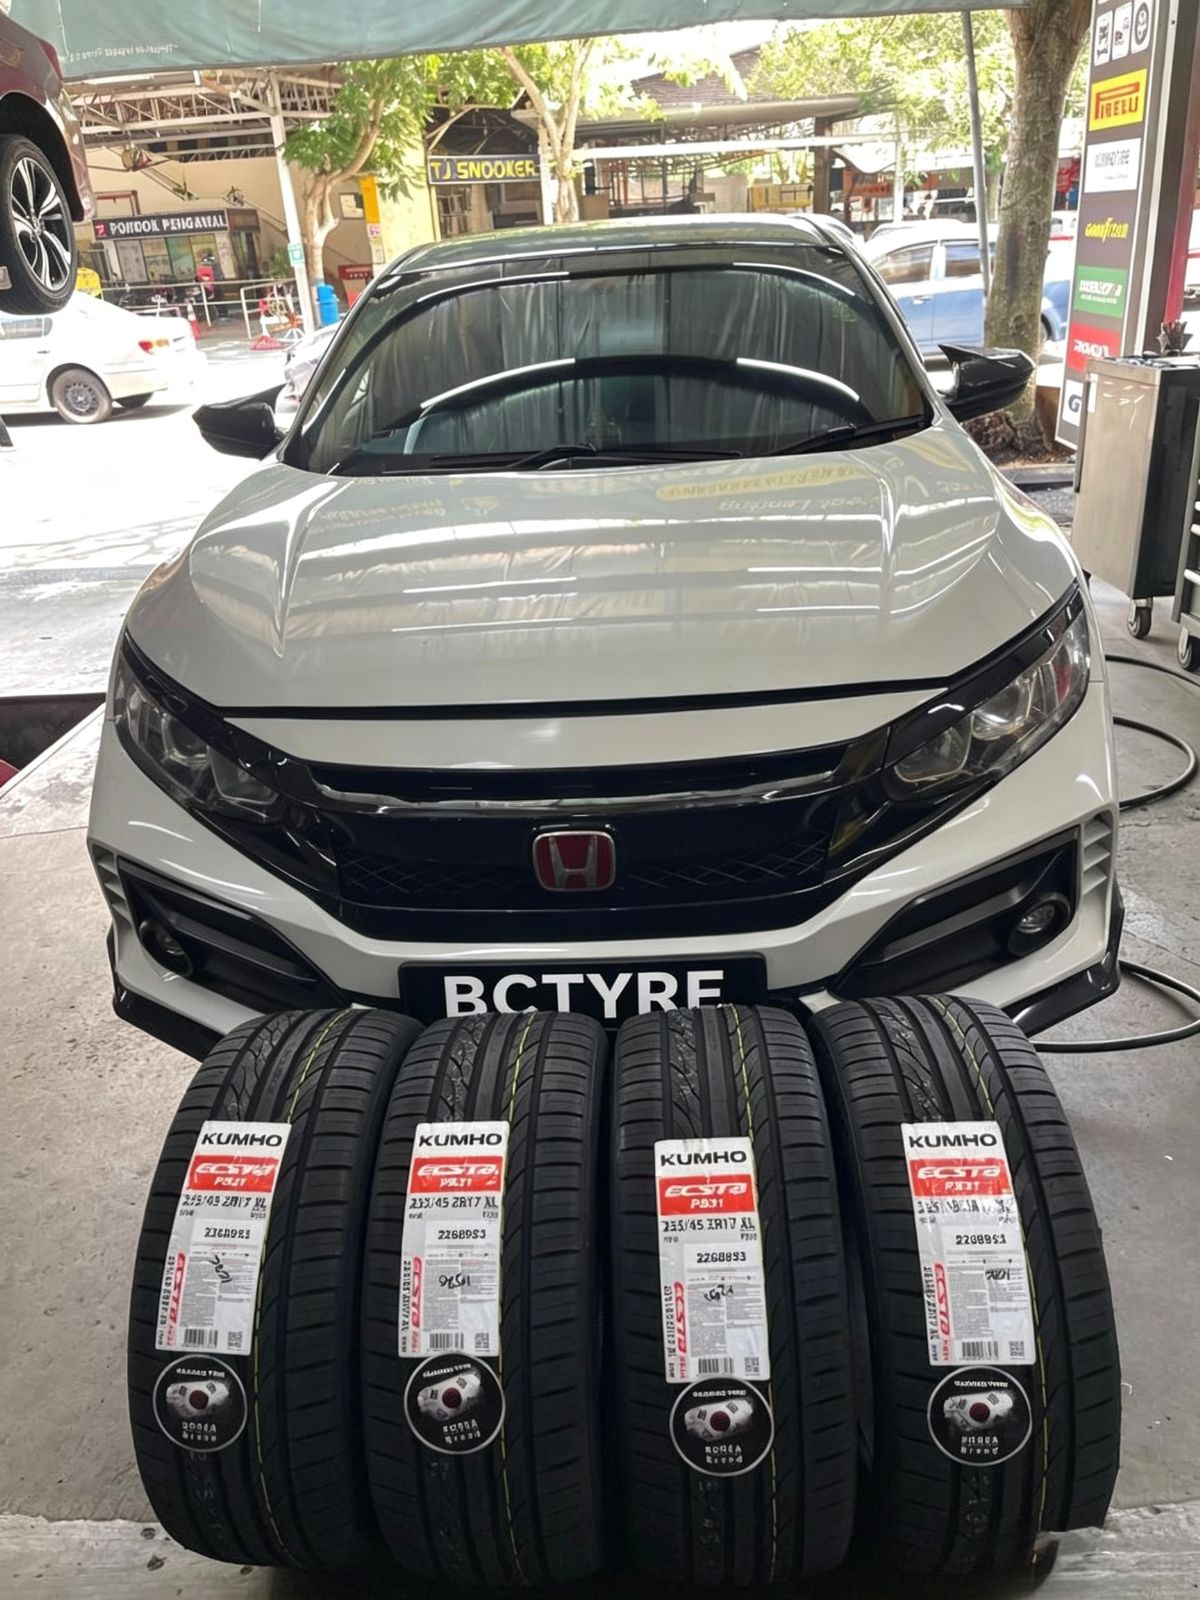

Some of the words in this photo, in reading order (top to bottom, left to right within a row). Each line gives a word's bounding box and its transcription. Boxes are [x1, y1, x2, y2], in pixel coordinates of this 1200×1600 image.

[1094, 81, 1140, 120] PIRELLI
[457, 159, 536, 179] SNOOKER
[201, 1132, 283, 1147] KUMHO
[418, 1133, 503, 1147] KUMHO
[908, 1133, 998, 1148] KUMHO
[660, 1150, 748, 1167] KUMHO
